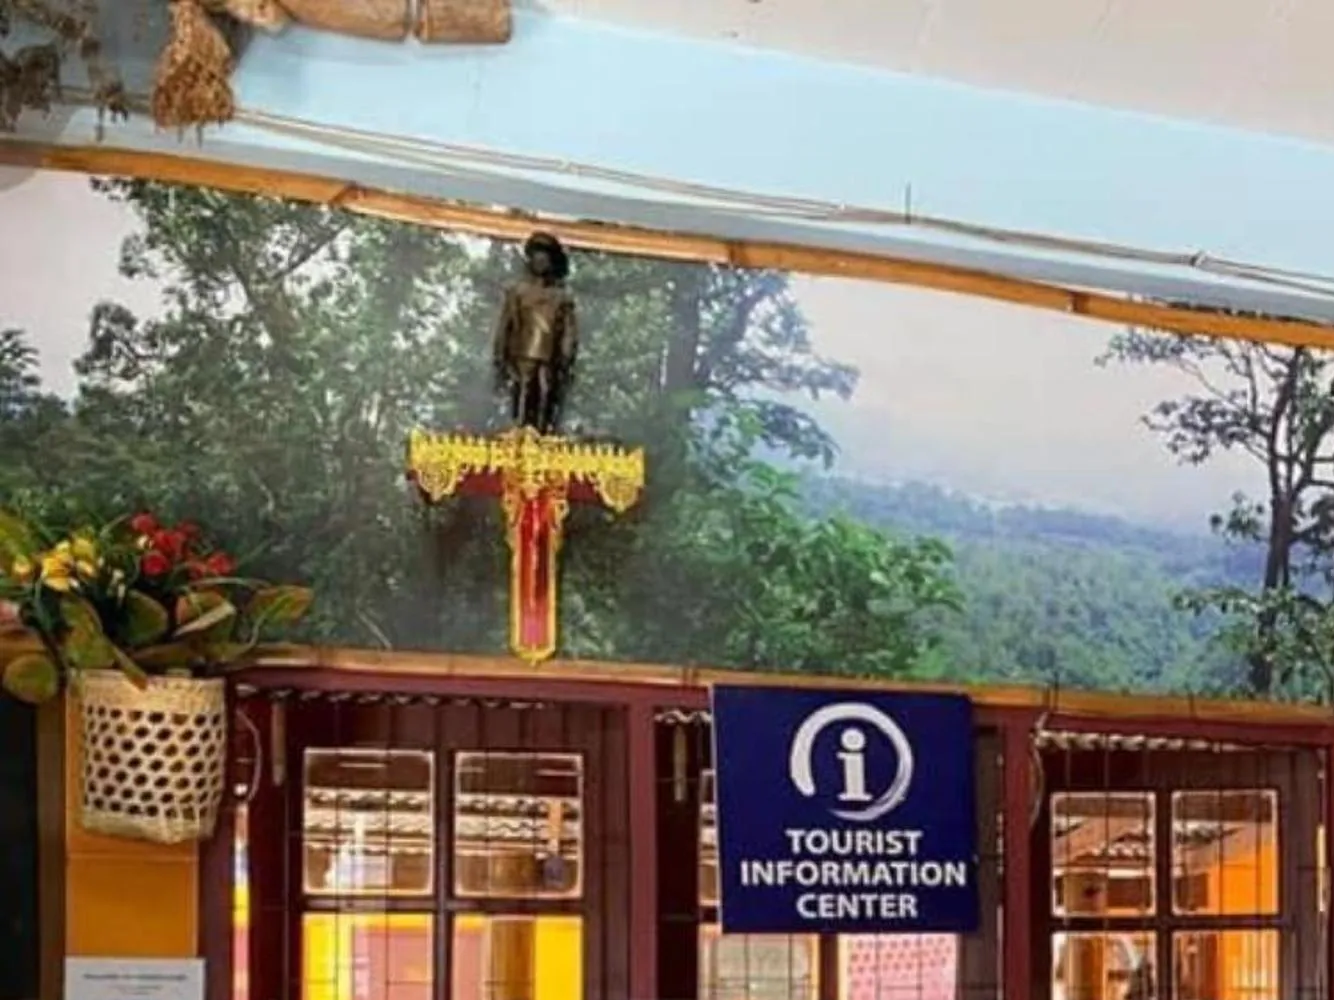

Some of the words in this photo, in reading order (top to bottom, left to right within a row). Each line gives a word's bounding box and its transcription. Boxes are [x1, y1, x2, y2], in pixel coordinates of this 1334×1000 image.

[785, 828, 923, 856] TOURIST
[740, 859, 966, 888] INFORMATION
[795, 892, 919, 920] CENTER
